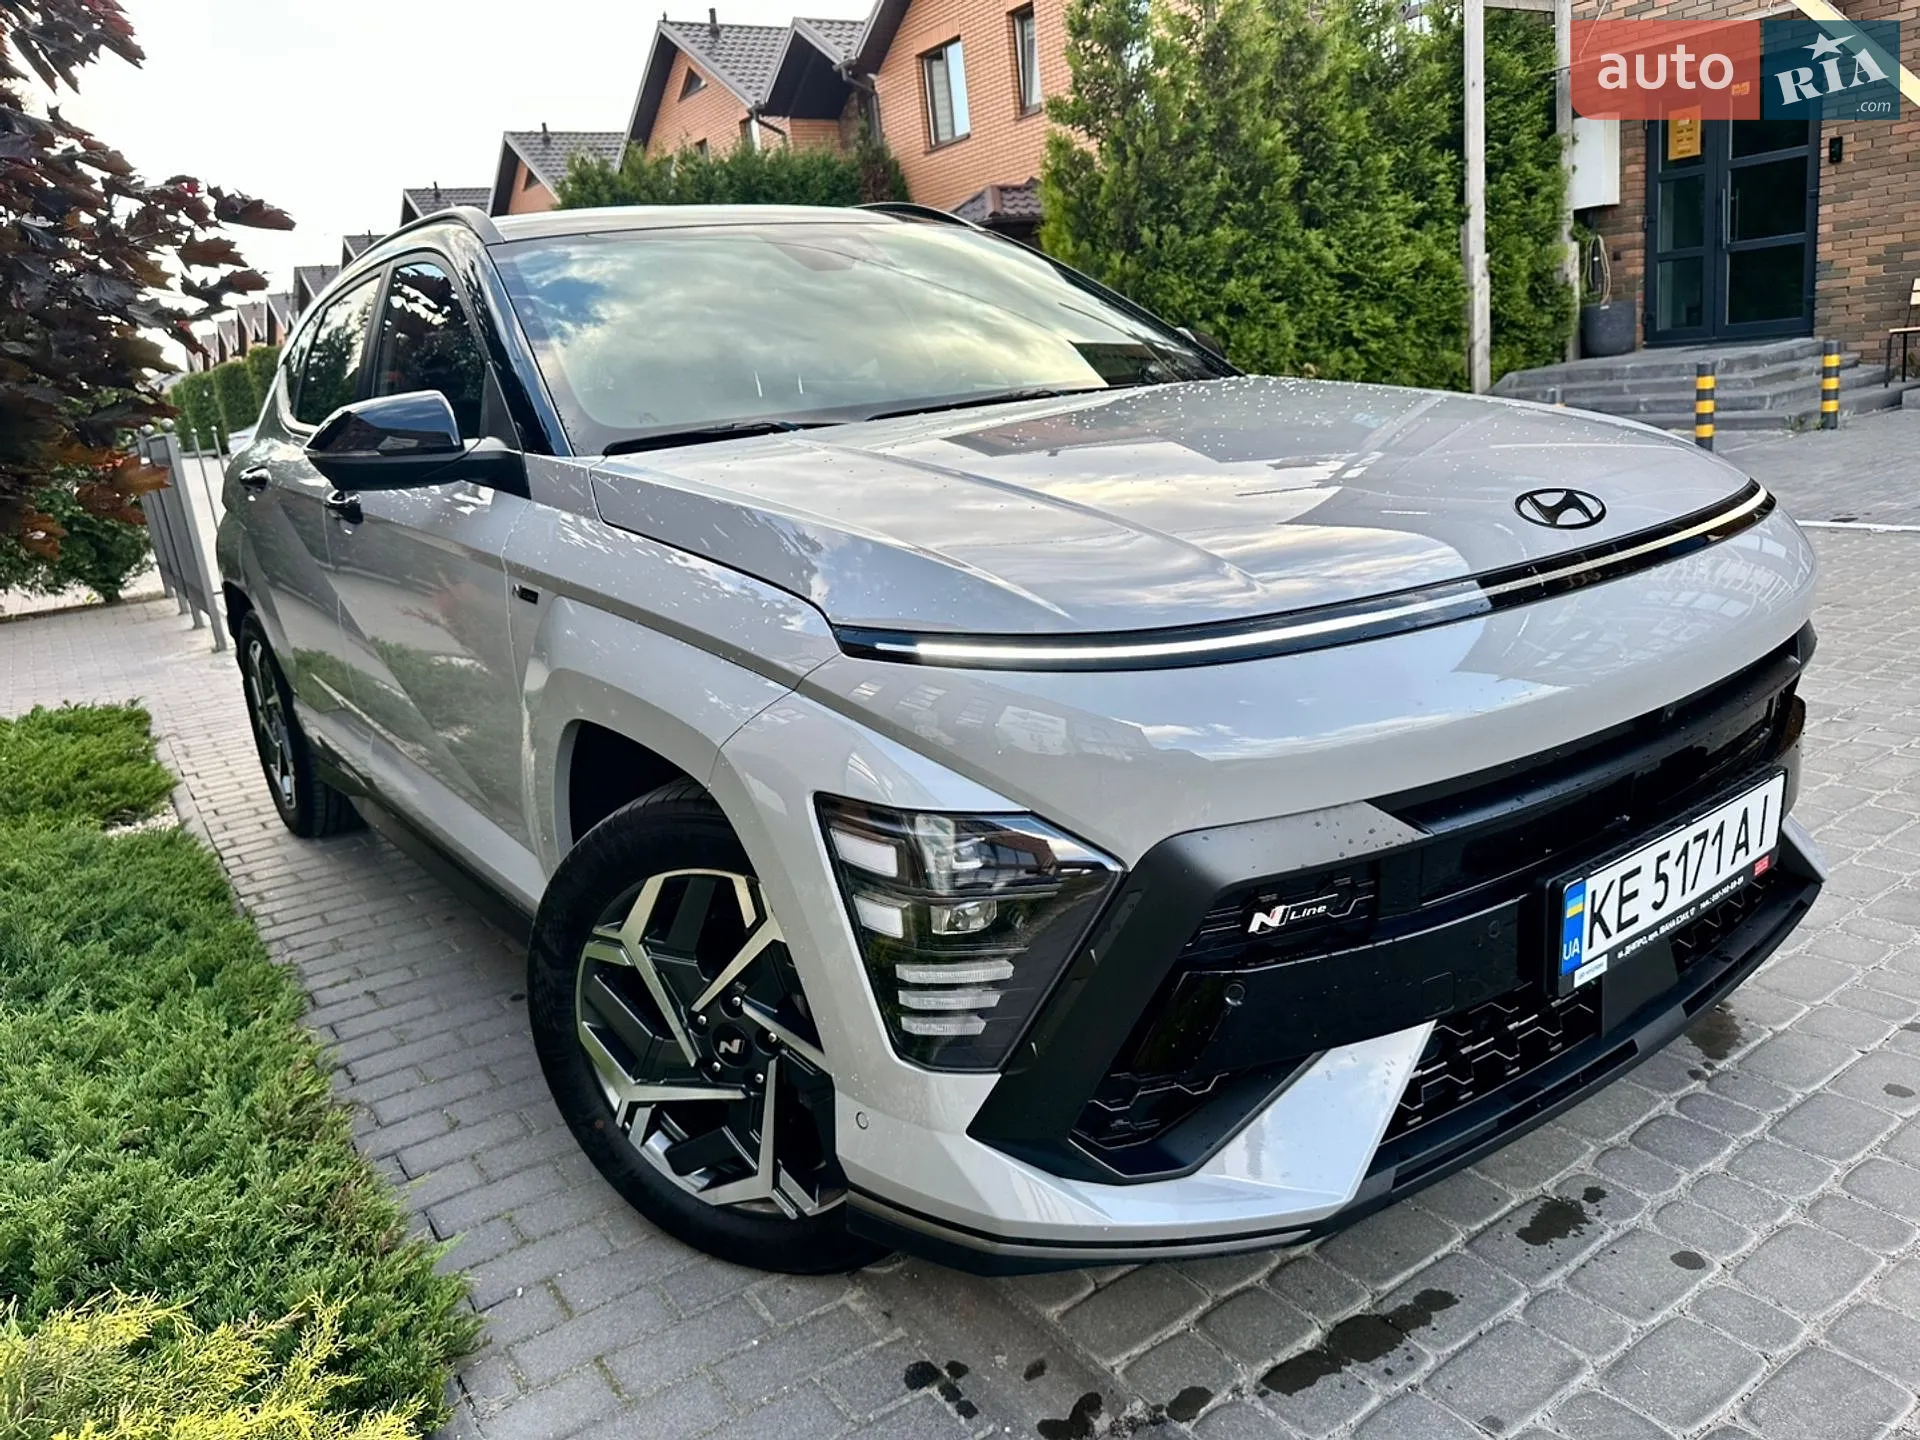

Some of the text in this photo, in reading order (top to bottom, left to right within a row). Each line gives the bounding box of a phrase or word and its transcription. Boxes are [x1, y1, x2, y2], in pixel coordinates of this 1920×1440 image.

[1587, 794, 1769, 951] KE 5171 AI
[1290, 905, 1327, 920] Line
[1563, 937, 1580, 960] UA
